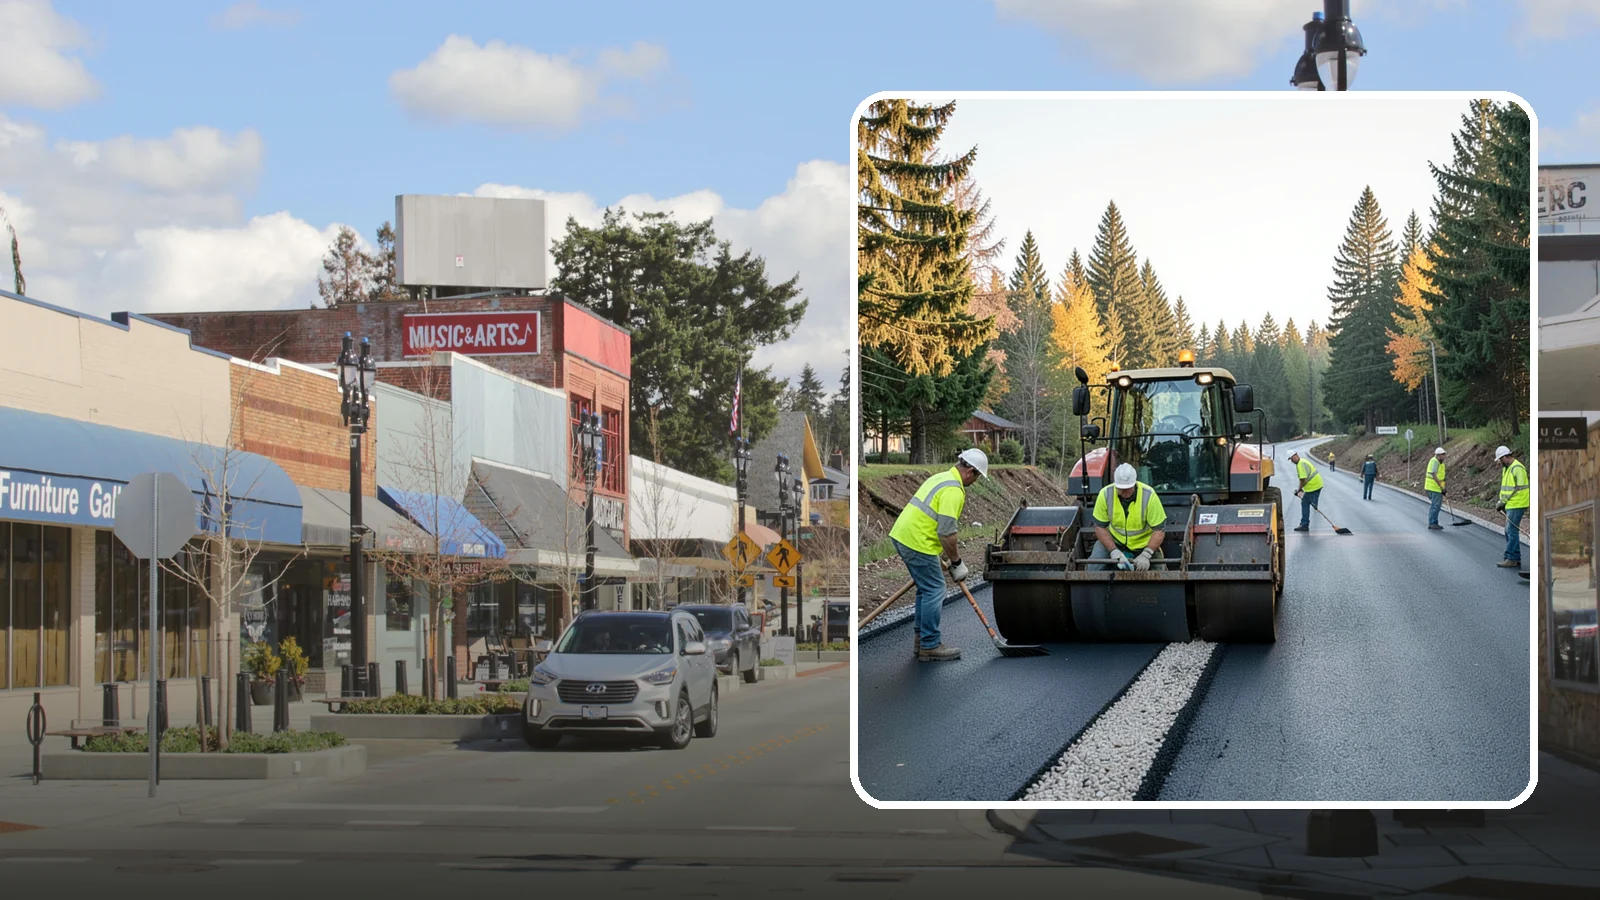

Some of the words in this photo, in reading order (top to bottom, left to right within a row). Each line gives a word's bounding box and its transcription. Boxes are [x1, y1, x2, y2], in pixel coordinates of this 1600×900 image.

[1540, 427, 1578, 437] UGA
[0, 471, 79, 515] Furniture
[89, 482, 122, 519] Gal
[453, 562, 479, 574] SUSHI
